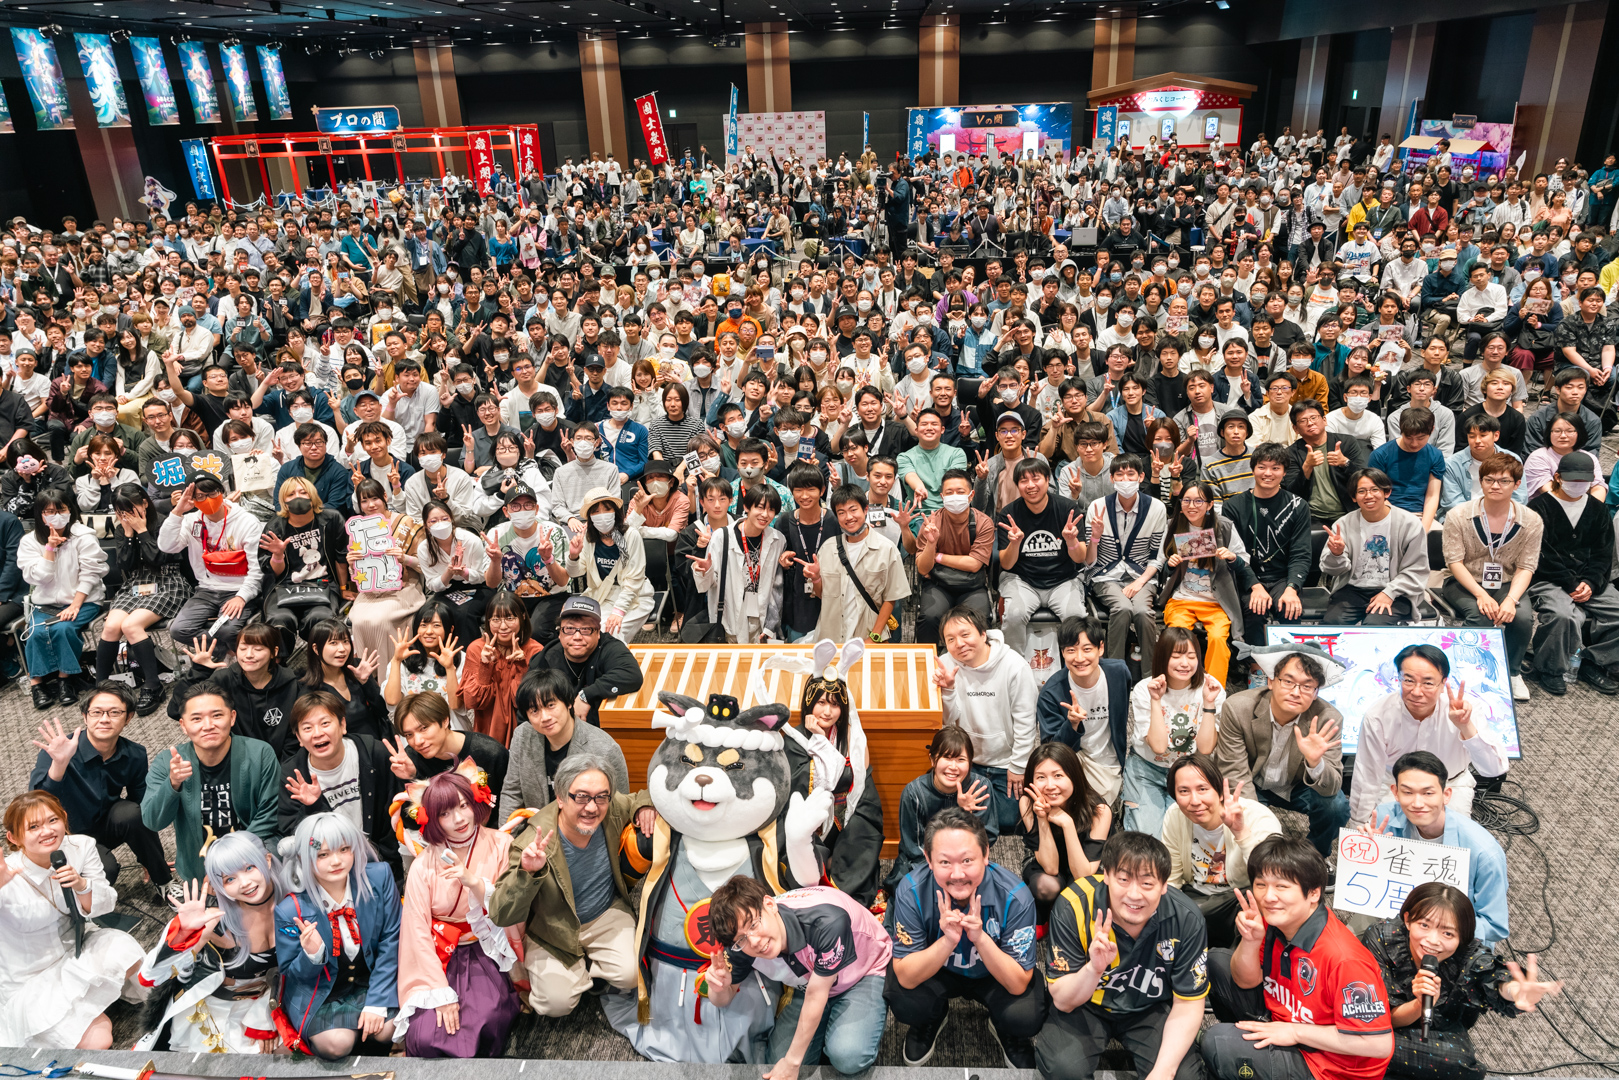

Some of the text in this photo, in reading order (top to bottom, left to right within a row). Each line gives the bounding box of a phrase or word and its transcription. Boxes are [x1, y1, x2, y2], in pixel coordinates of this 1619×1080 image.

[1148, 95, 1191, 103] みくじコーナー
[330, 111, 386, 128] プロの間
[976, 114, 1003, 126] Vの間
[523, 133, 534, 181] 嶺上開
[153, 456, 187, 487] 堀
[289, 529, 320, 543] SECRET
[1021, 540, 1062, 553] ALLDAY
[573, 602, 594, 610] Supreme
[1344, 839, 1460, 885] 祝 雀魂
[1342, 1000, 1387, 1018] ACHILLES
